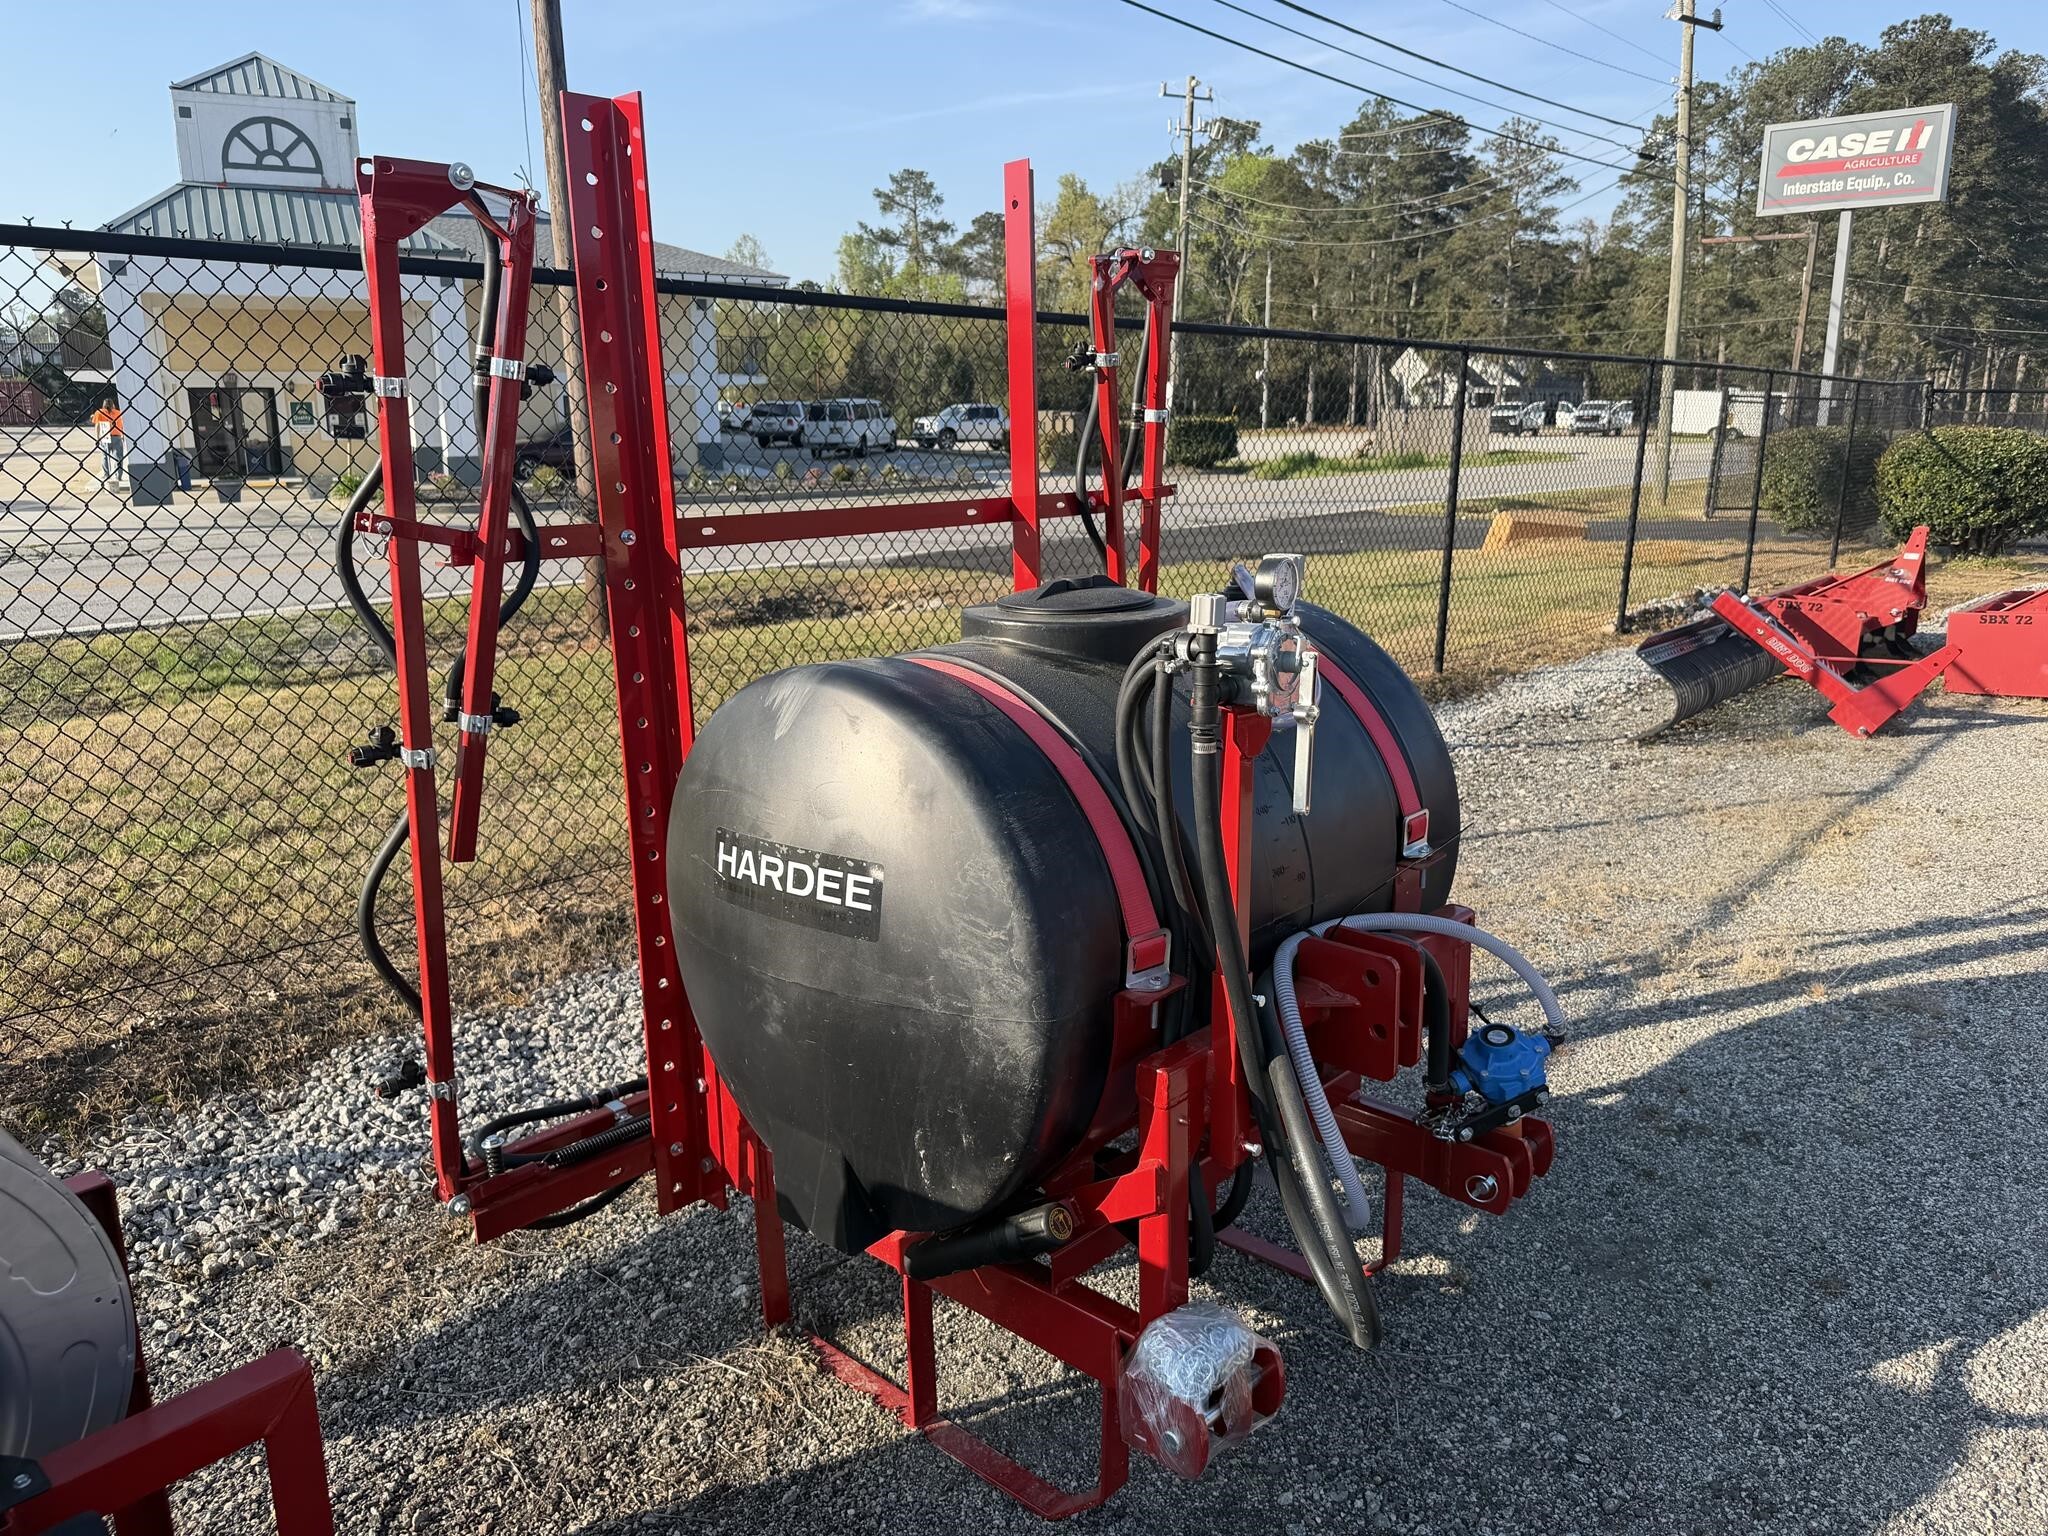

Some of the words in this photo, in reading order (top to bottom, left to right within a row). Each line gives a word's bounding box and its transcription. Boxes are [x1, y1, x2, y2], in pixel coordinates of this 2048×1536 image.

[1786, 129, 1895, 163] CASE
[1843, 153, 1918, 171] AGRICULTURE
[1782, 176, 1844, 197] Interstate
[1847, 175, 1890, 193] Equip.,
[1894, 172, 1915, 186] Co.
[1807, 602, 1823, 612] 72
[1979, 614, 2010, 625] SBX
[2015, 615, 2033, 625] 72
[1765, 635, 1792, 656] DIRT
[1786, 653, 1810, 673] DOG
[717, 841, 874, 912] HARDEE
